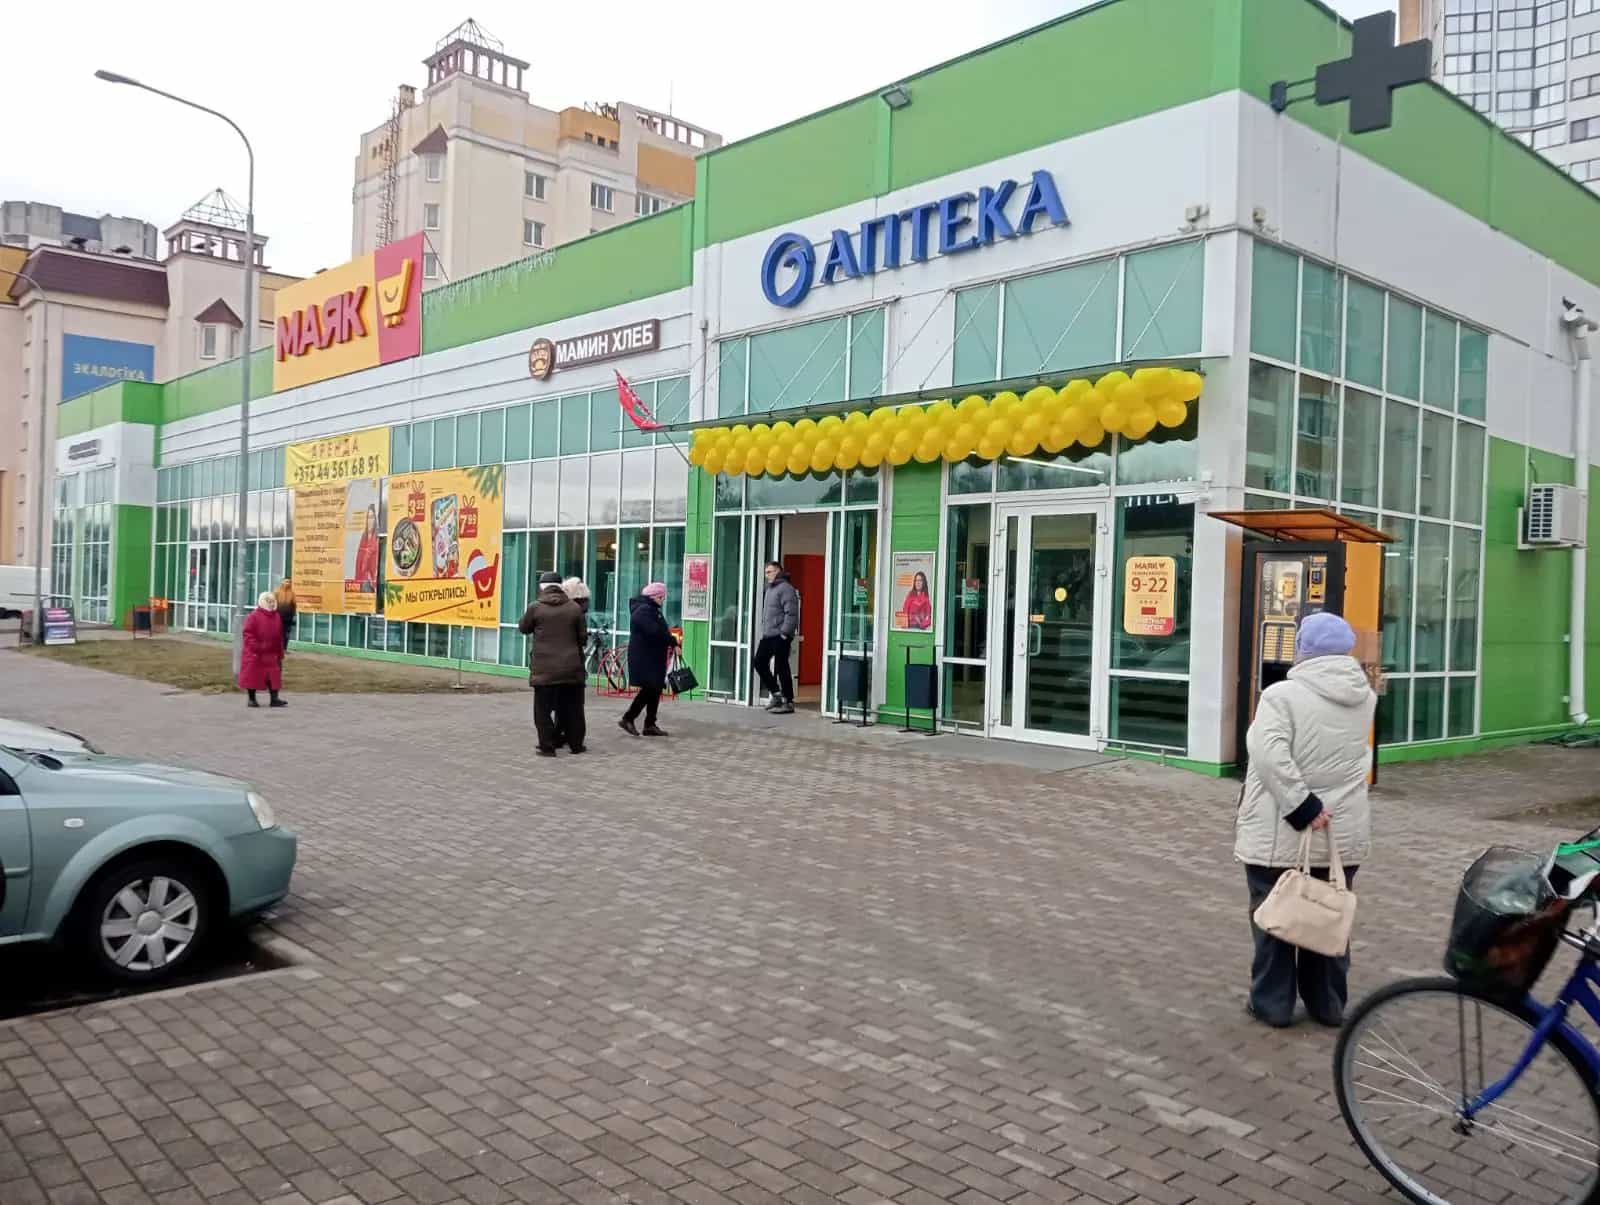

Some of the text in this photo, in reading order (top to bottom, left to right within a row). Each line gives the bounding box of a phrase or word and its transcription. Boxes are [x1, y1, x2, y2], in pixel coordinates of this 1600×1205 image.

[820, 169, 1072, 285] АПТЕКА
[275, 285, 369, 362] МАЯК
[555, 324, 654, 363] МАМИН ХЛЕБ
[405, 586, 467, 602] МЫ ОТКРЫЛИСЬ!
[1131, 576, 1168, 593] 9-22
